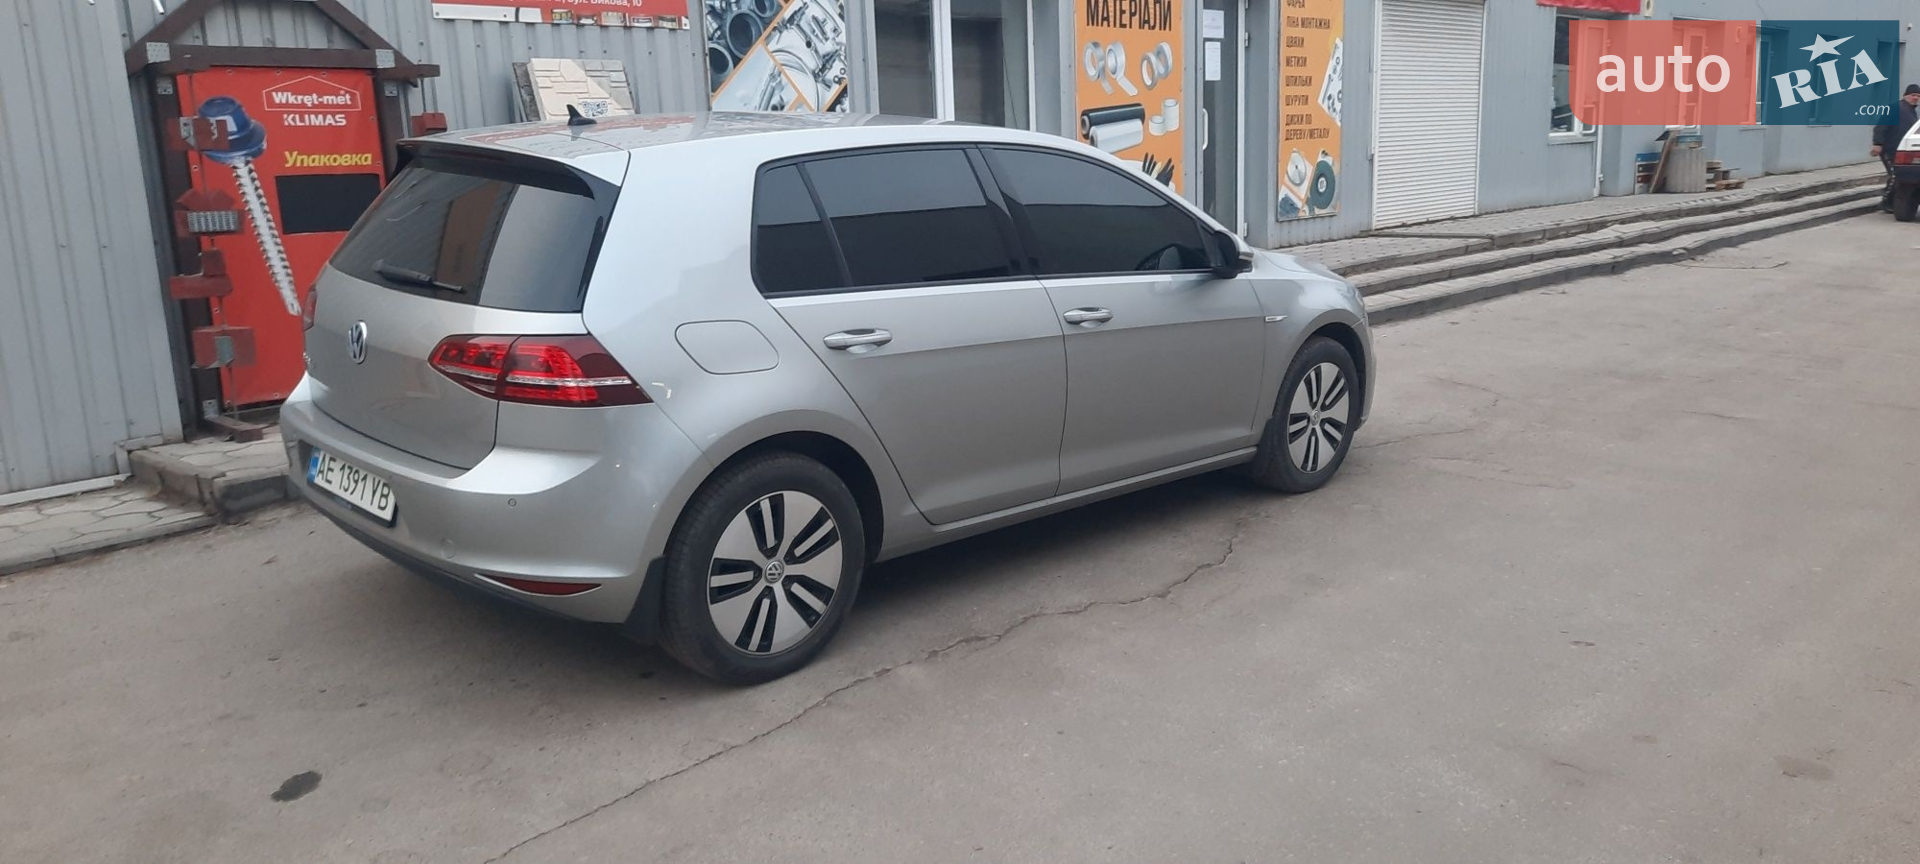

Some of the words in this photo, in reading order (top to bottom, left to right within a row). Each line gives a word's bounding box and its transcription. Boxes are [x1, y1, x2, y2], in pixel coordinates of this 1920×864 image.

[1087, 0, 1171, 31] МАТЕРІАЛИ
[1301, 17, 1330, 29] МОНТАЖНА
[1286, 56, 1307, 67] МЕТИЗИ
[1285, 76, 1312, 87] ШПИЛЬКИ
[272, 91, 352, 107] Wkręt-met
[283, 114, 347, 126] KLIMAS
[284, 151, 373, 167] Упаковка
[316, 453, 337, 485] AE
[339, 463, 368, 501] 1391
[370, 477, 391, 511] YB
